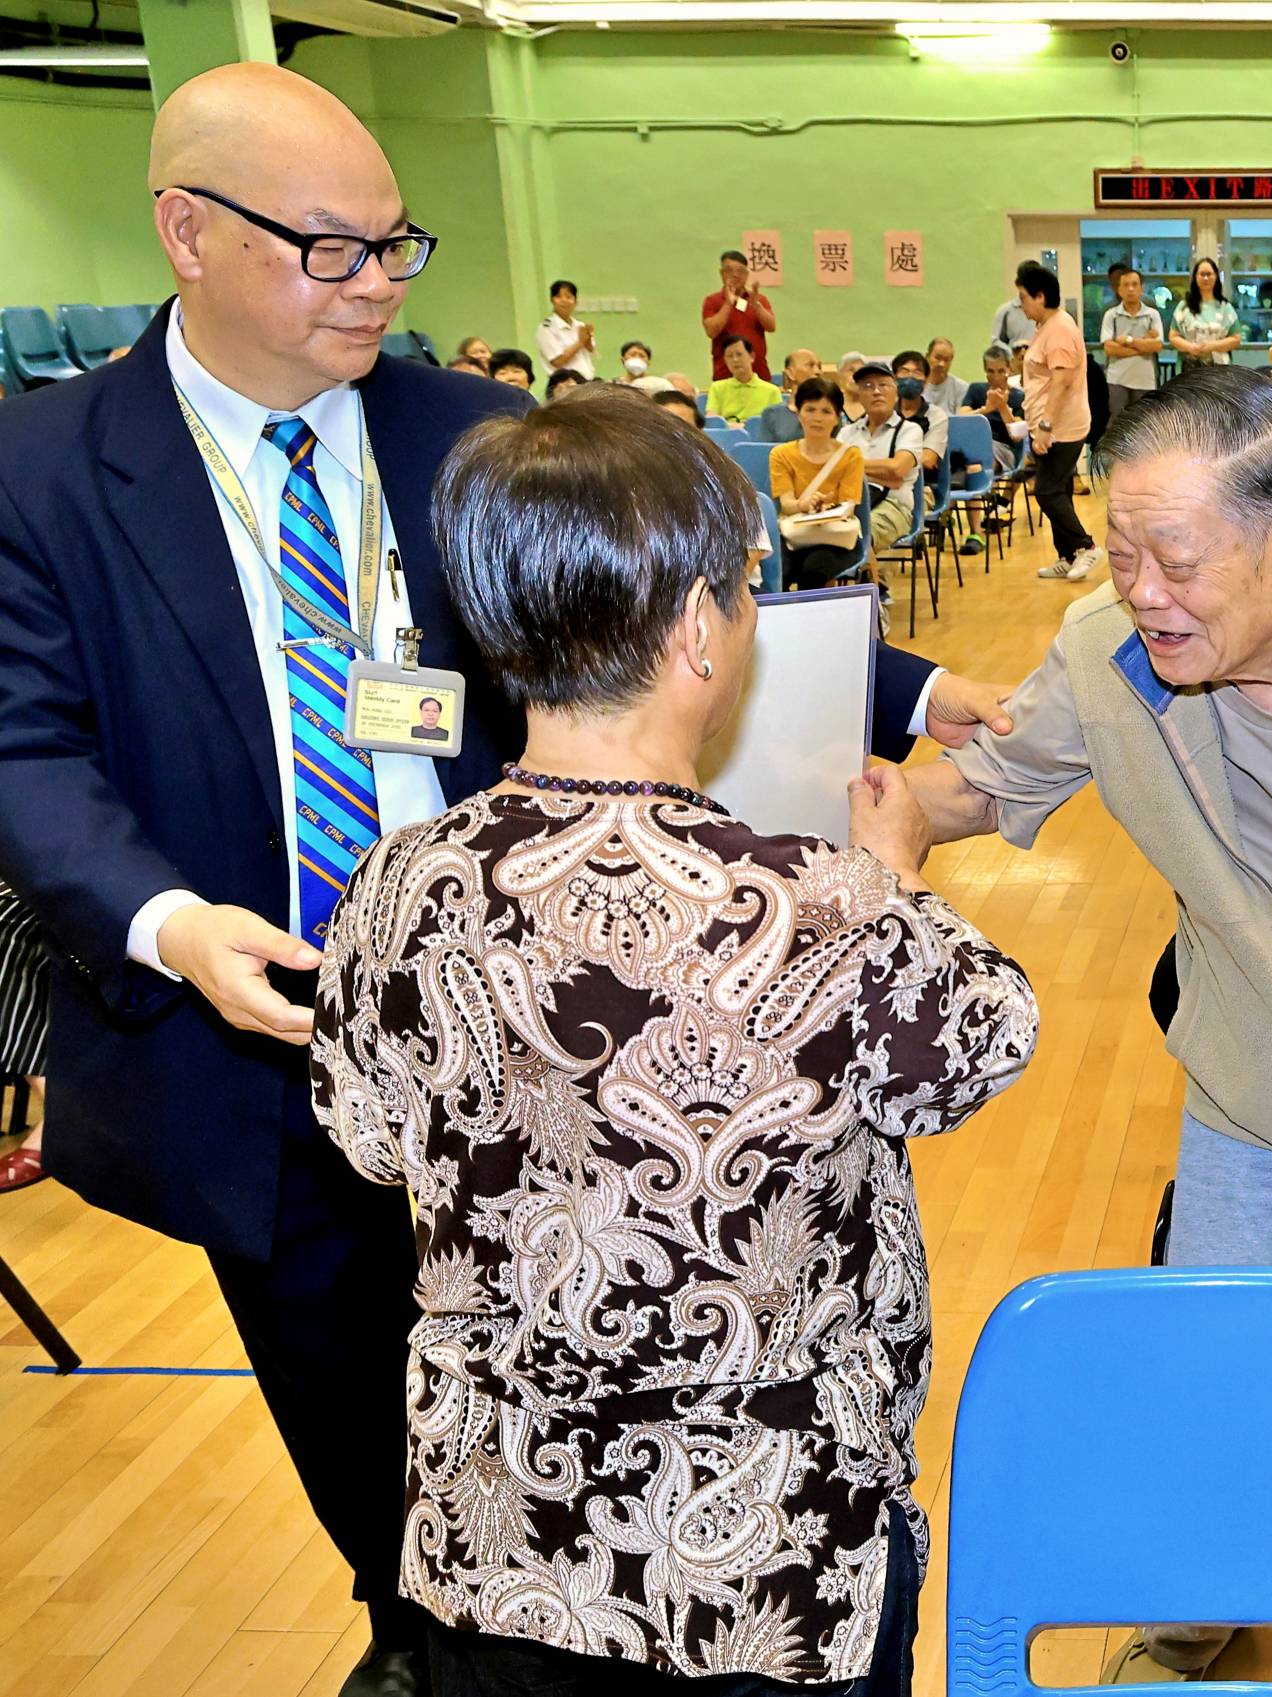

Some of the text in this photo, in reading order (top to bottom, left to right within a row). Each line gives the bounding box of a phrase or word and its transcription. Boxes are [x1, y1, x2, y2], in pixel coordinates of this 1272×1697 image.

[1160, 177, 1244, 199] EXIT
[750, 241, 919, 273] 換 票 處
[202, 441, 227, 474] GROUP
[363, 483, 377, 577] www.chevalier.com
[302, 708, 322, 728] CPML
[299, 805, 320, 825] CPML
[324, 824, 345, 844] CPML
